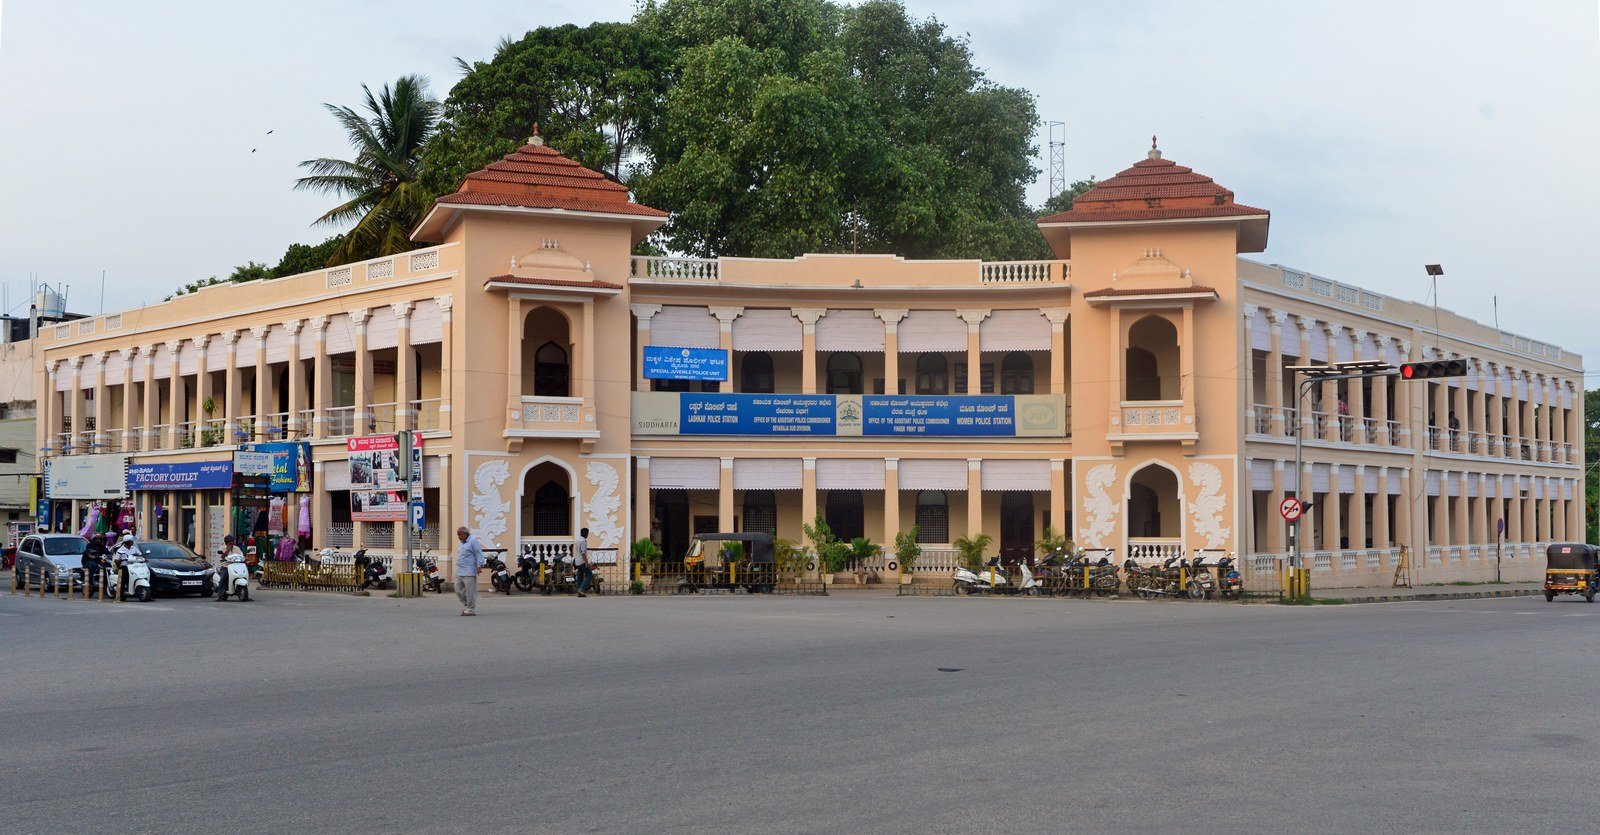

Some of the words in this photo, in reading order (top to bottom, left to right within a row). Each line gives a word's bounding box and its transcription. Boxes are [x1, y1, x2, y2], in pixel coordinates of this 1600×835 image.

[136, 473, 169, 482] FACTORY
[170, 472, 198, 481] OUTLET
[413, 506, 424, 526] P
